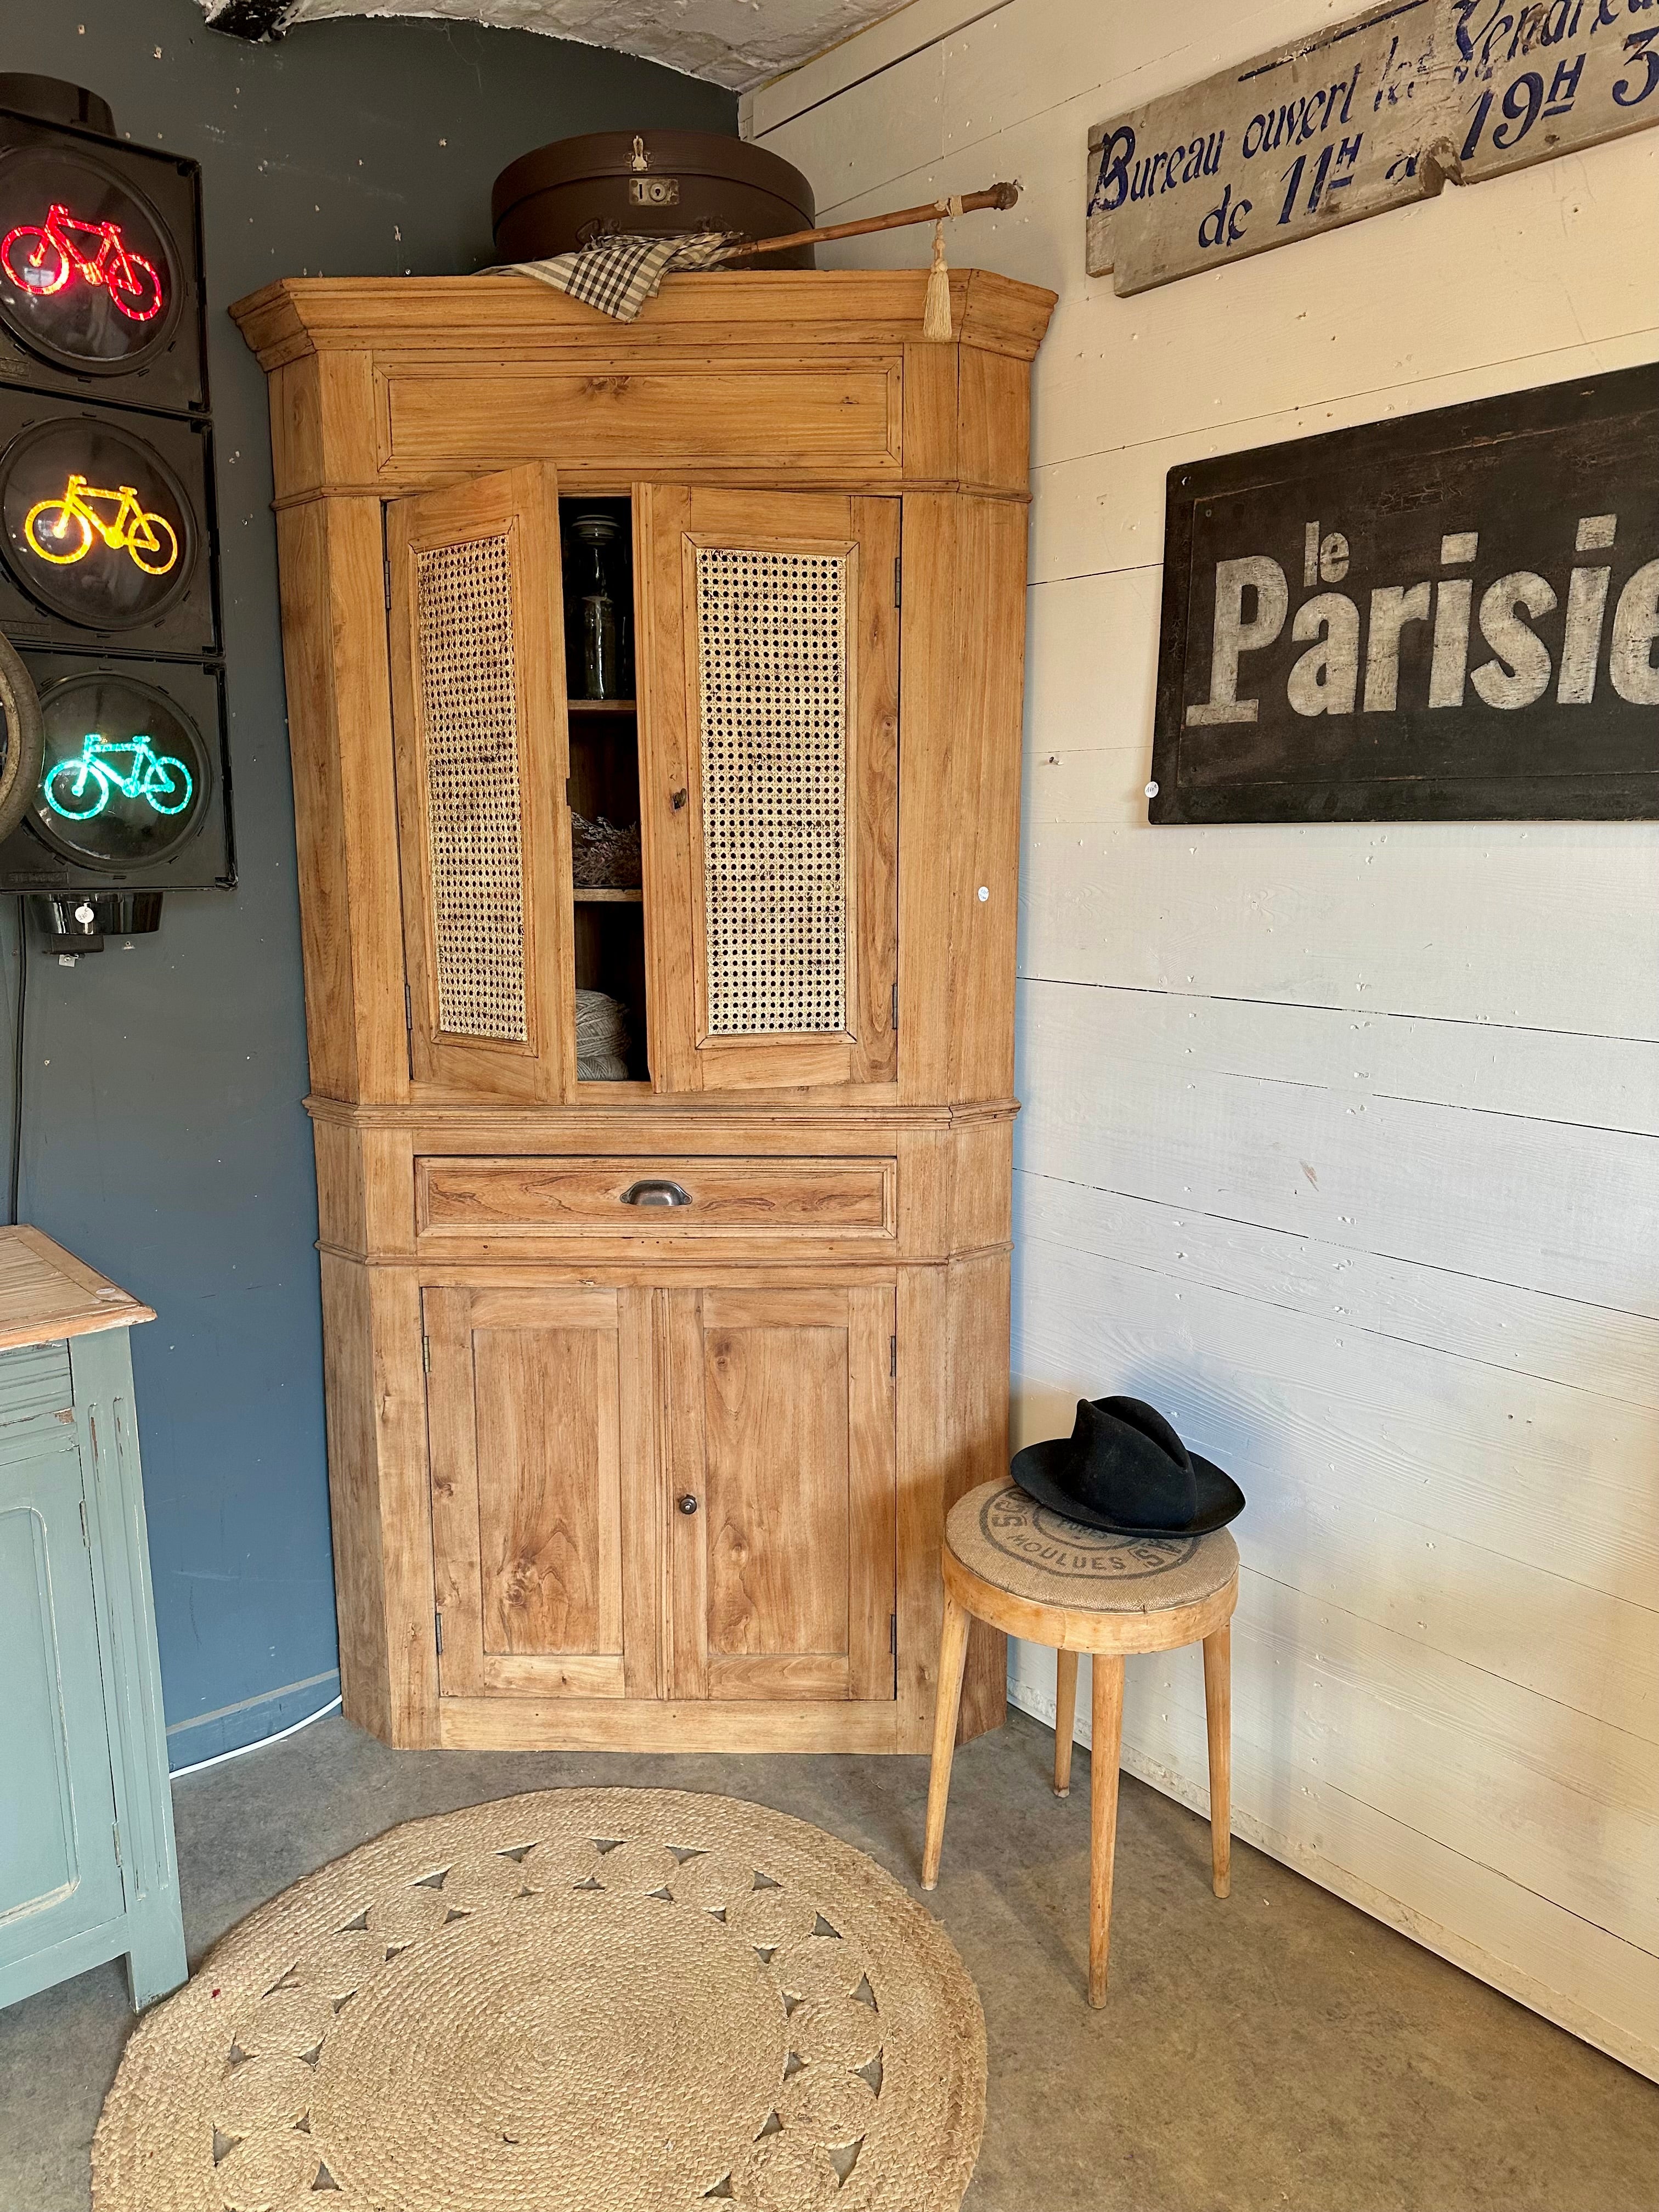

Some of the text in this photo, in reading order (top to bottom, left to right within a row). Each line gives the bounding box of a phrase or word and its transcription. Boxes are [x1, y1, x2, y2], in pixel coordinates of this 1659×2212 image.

[1086, 125, 1225, 217] Bureau
[1242, 64, 1364, 160] ouvert
[1198, 183, 1253, 247] de
[1303, 520, 1350, 588] le
[1005, 1534, 1127, 1570] MOULUES
